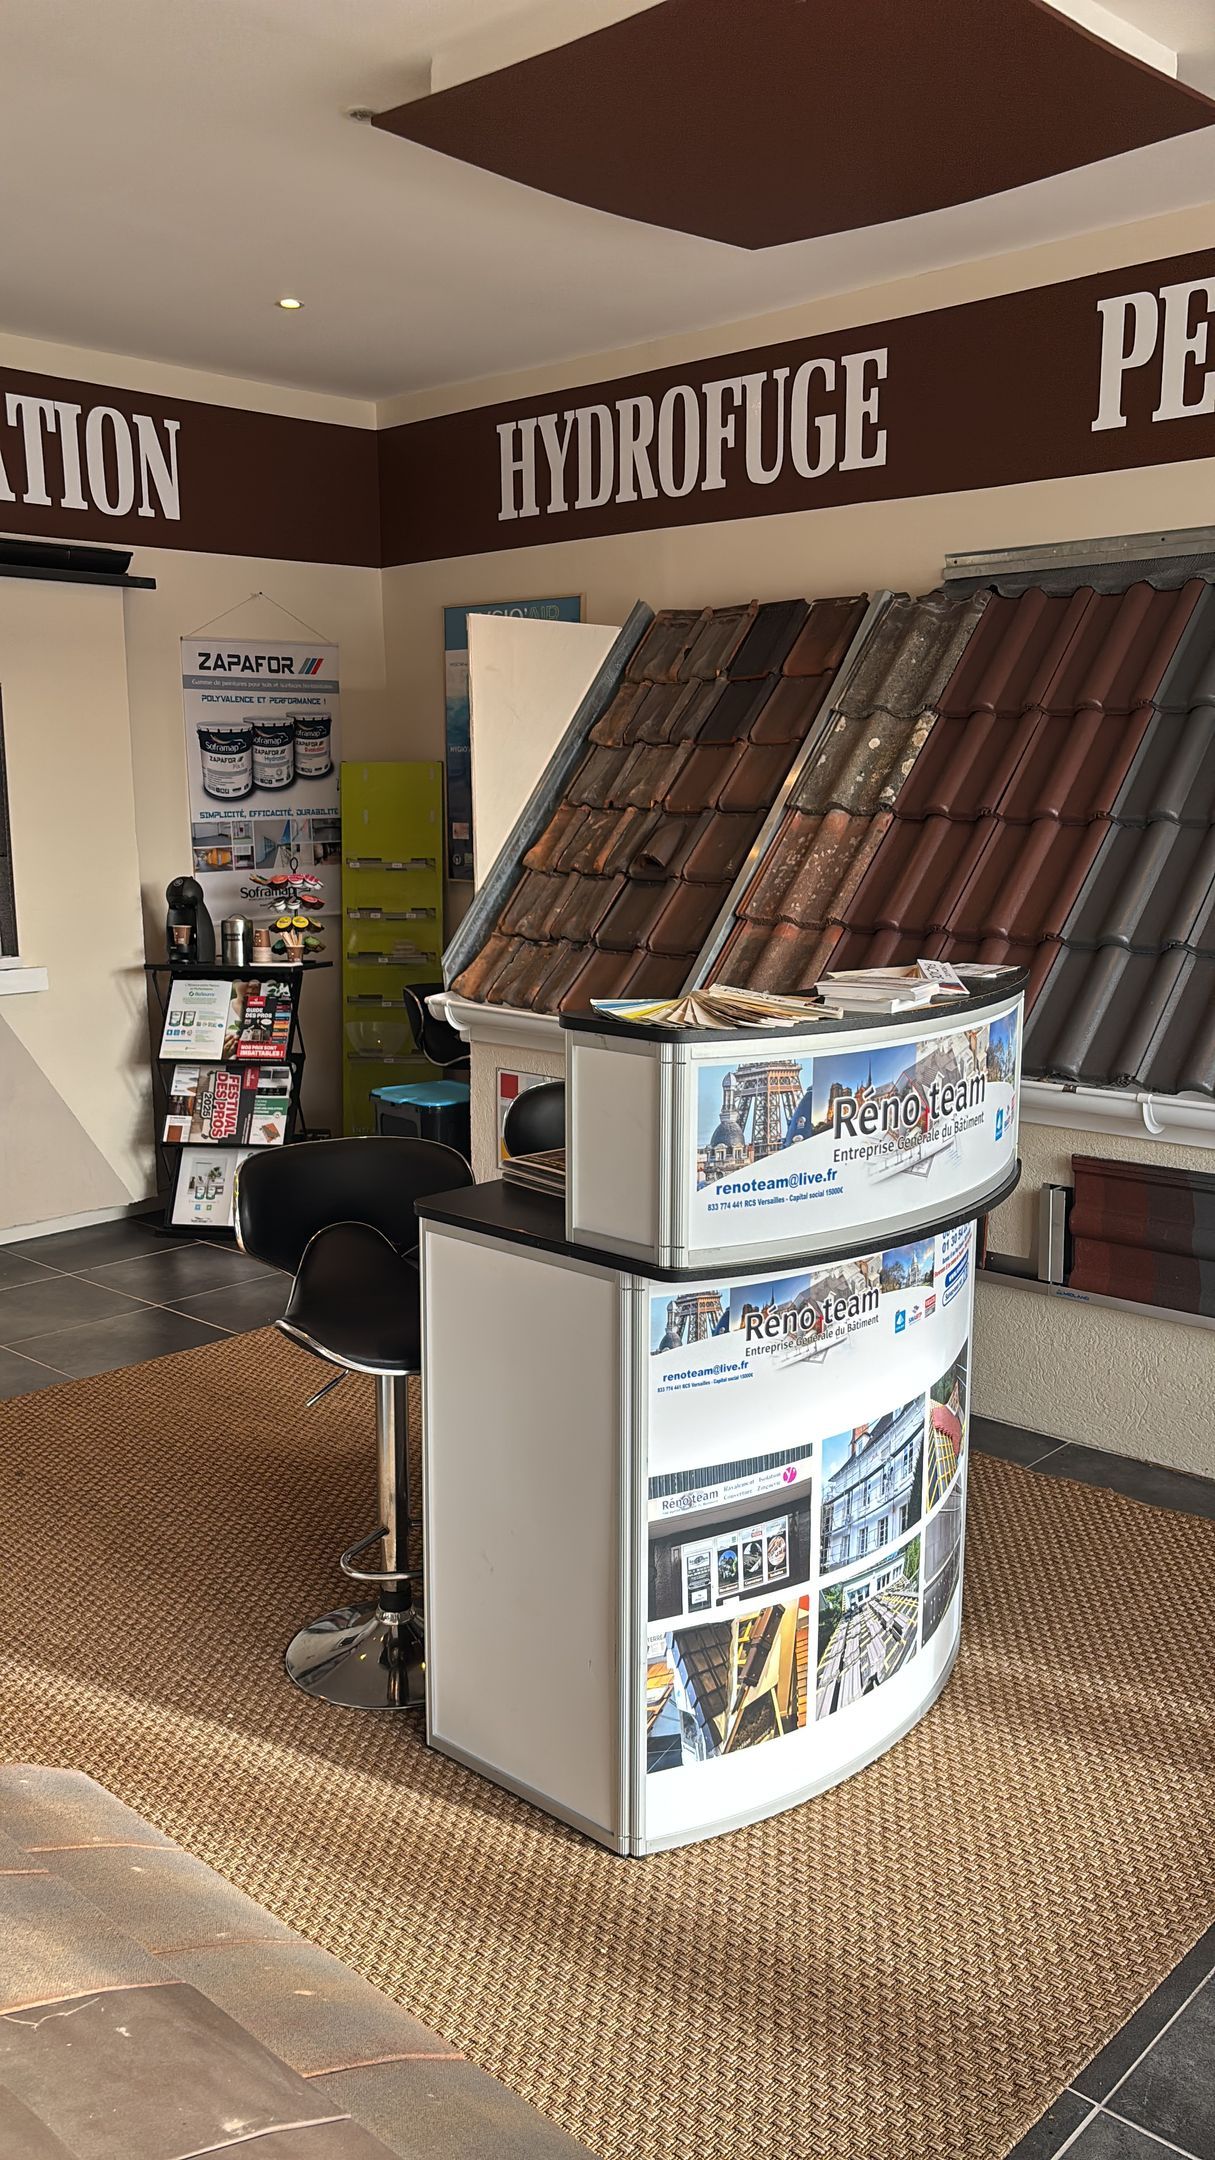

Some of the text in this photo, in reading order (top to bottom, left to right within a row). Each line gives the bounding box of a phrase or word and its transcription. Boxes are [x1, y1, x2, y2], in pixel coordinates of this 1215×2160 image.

[1091, 276, 1215, 432] PE
[496, 347, 888, 521] HYDROFUGE
[197, 652, 295, 675] ZAPAFOR
[201, 694, 254, 704] POLYVALENCE
[257, 696, 267, 704] ET
[269, 696, 321, 705] PERFORMANCE
[205, 740, 240, 754] Soframap
[209, 755, 237, 764] ZAPAFOR
[200, 809, 247, 819] SIMPLICITÉ,
[202, 1092, 213, 1118] 2025
[212, 1072, 229, 1138] DES PROS
[223, 1074, 241, 1136] FESTIVAL
[834, 1073, 985, 1140] Réno team
[833, 1139, 895, 1163] Entreprise
[942, 1125, 952, 1137] du
[954, 1112, 985, 1134] Bâtiment
[716, 1168, 838, 1195] renoteam@live.fr
[707, 1203, 719, 1211] 833
[720, 1202, 731, 1210] 774
[744, 1199, 757, 1207] RCS
[757, 1196, 785, 1205] Versailles
[789, 1192, 808, 1202] Capital
[809, 1189, 825, 1198] social
[826, 1186, 844, 1196] 15000€
[745, 1288, 879, 1341] Réno team
[745, 1340, 794, 1357] Entreprise
[835, 1326, 845, 1336] du
[847, 1315, 879, 1333] Bâtiment
[663, 1360, 749, 1382] renoteam@live.fr
